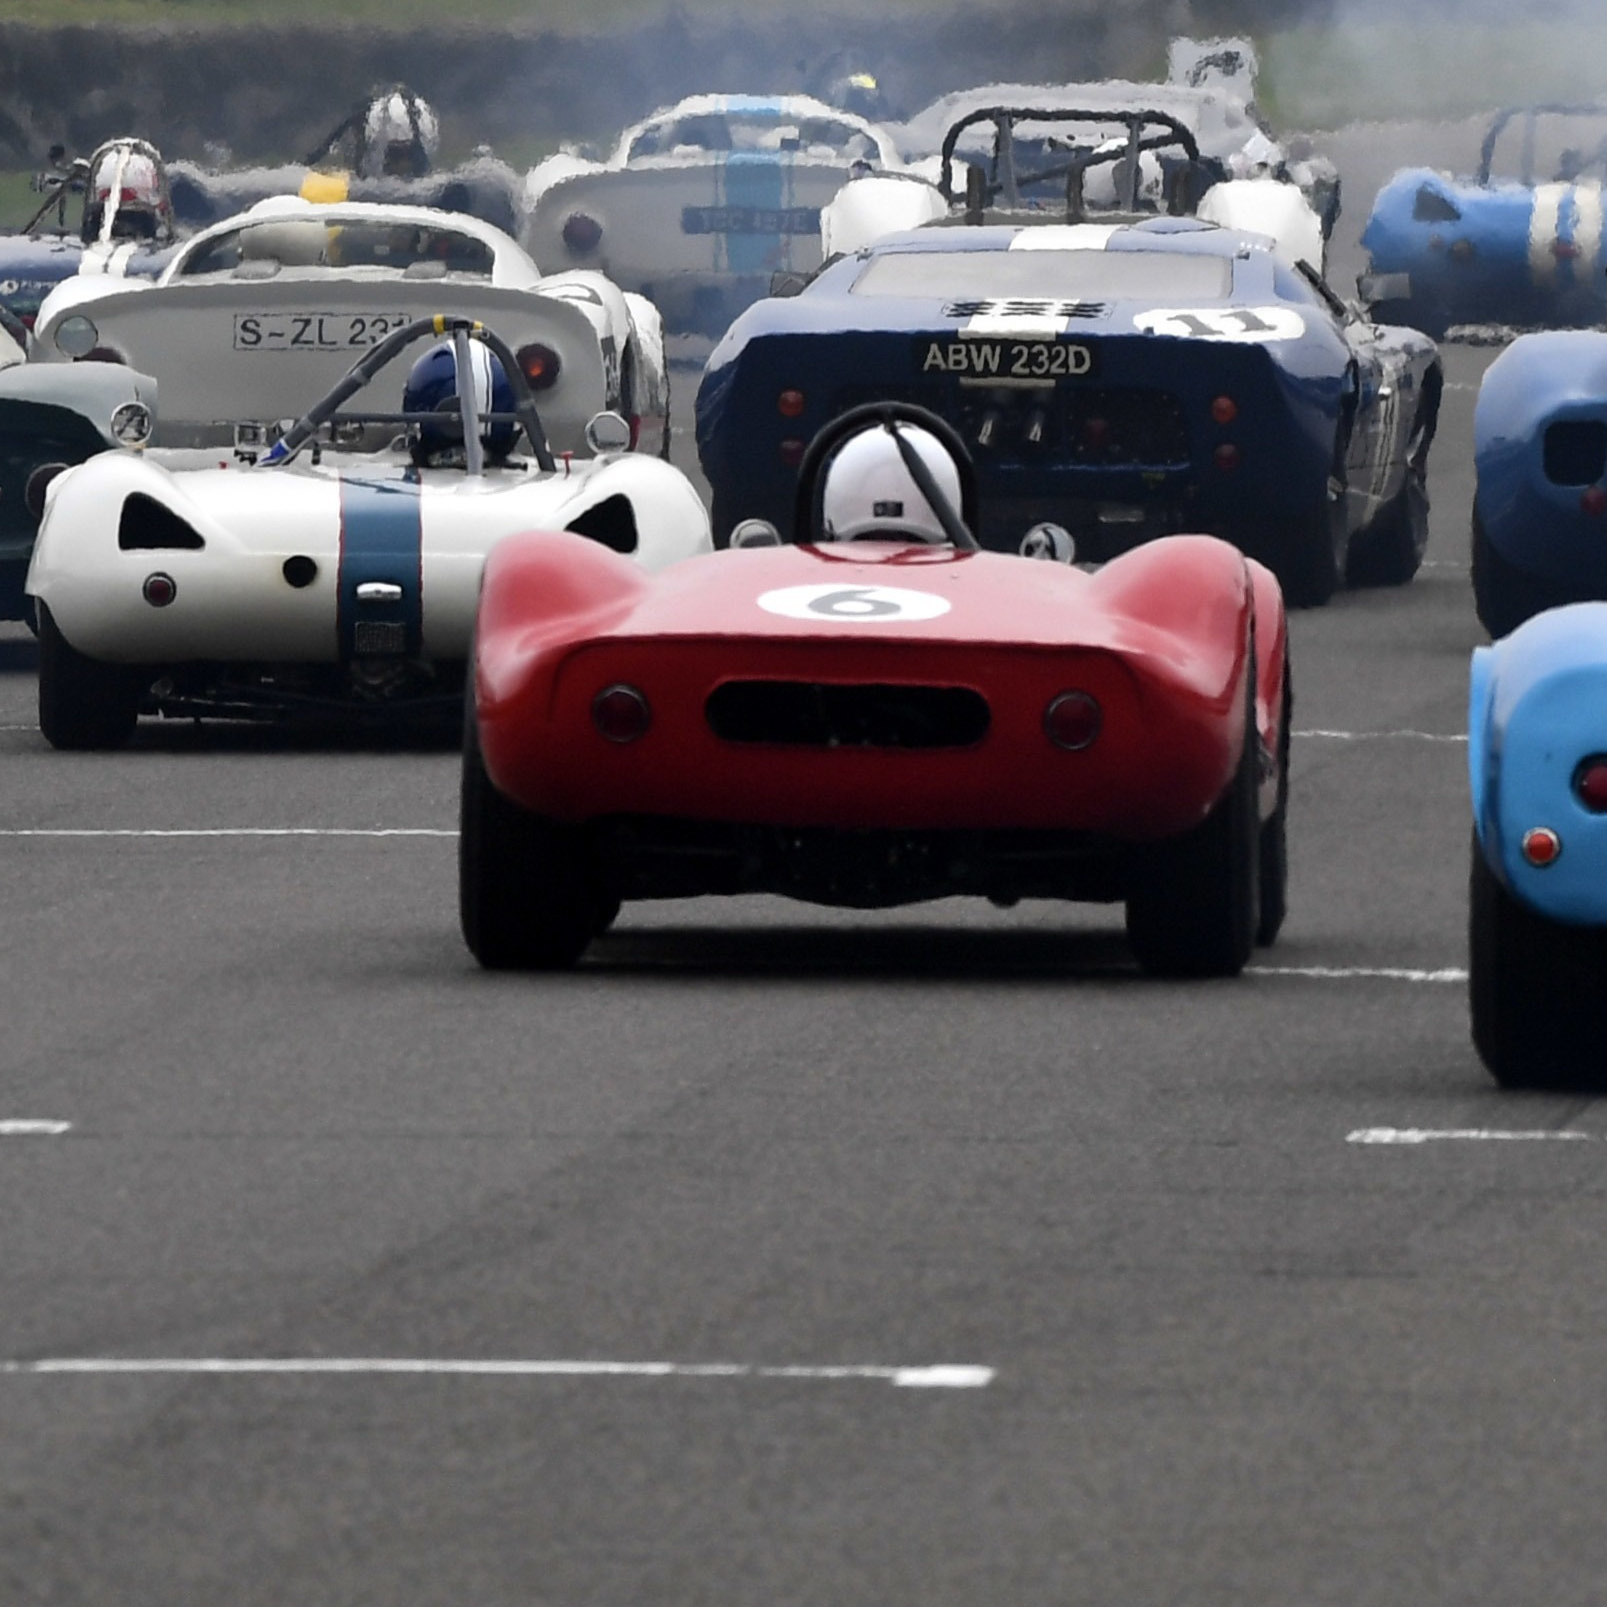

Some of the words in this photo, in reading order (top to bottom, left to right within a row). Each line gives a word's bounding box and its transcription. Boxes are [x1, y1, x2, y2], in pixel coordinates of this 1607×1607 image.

[922, 342, 1002, 373] ABW
[1010, 343, 1091, 375] 232D
[807, 588, 903, 617] 6
